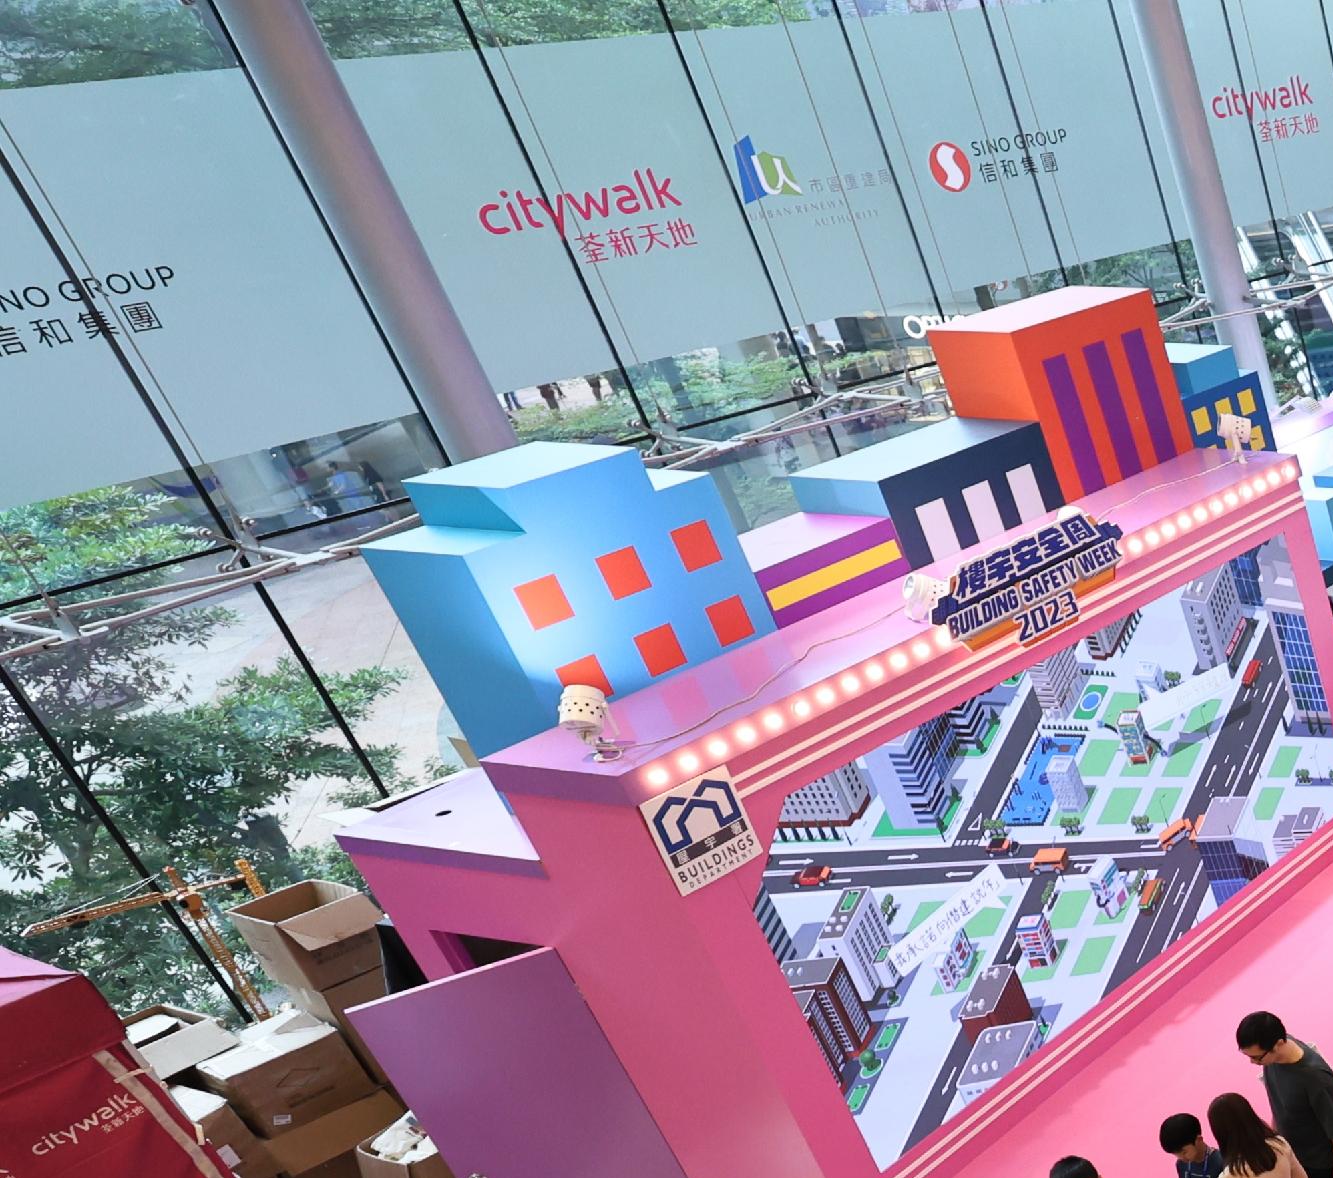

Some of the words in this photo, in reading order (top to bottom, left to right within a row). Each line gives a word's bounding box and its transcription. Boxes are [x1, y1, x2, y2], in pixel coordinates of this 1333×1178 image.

[1211, 74, 1314, 122] citywalk
[970, 136, 1011, 157] SINO
[1013, 128, 1067, 150] GROUP
[1257, 112, 1320, 143] 荃新天地
[979, 151, 1058, 183] 信和集團
[478, 167, 683, 240] citywalk
[574, 217, 698, 264] 荃新天地
[58, 265, 175, 302] GROUP
[956, 514, 1099, 599] 樓宇安全周
[949, 588, 1019, 640] BUILDING
[1020, 559, 1078, 603] SAFETY
[1077, 539, 1122, 574] WEEK
[1014, 591, 1079, 642] 2023
[678, 834, 754, 883] BUILDINGS
[689, 848, 753, 888] DEPARTMENT
[32, 1093, 137, 1156] citywalk
